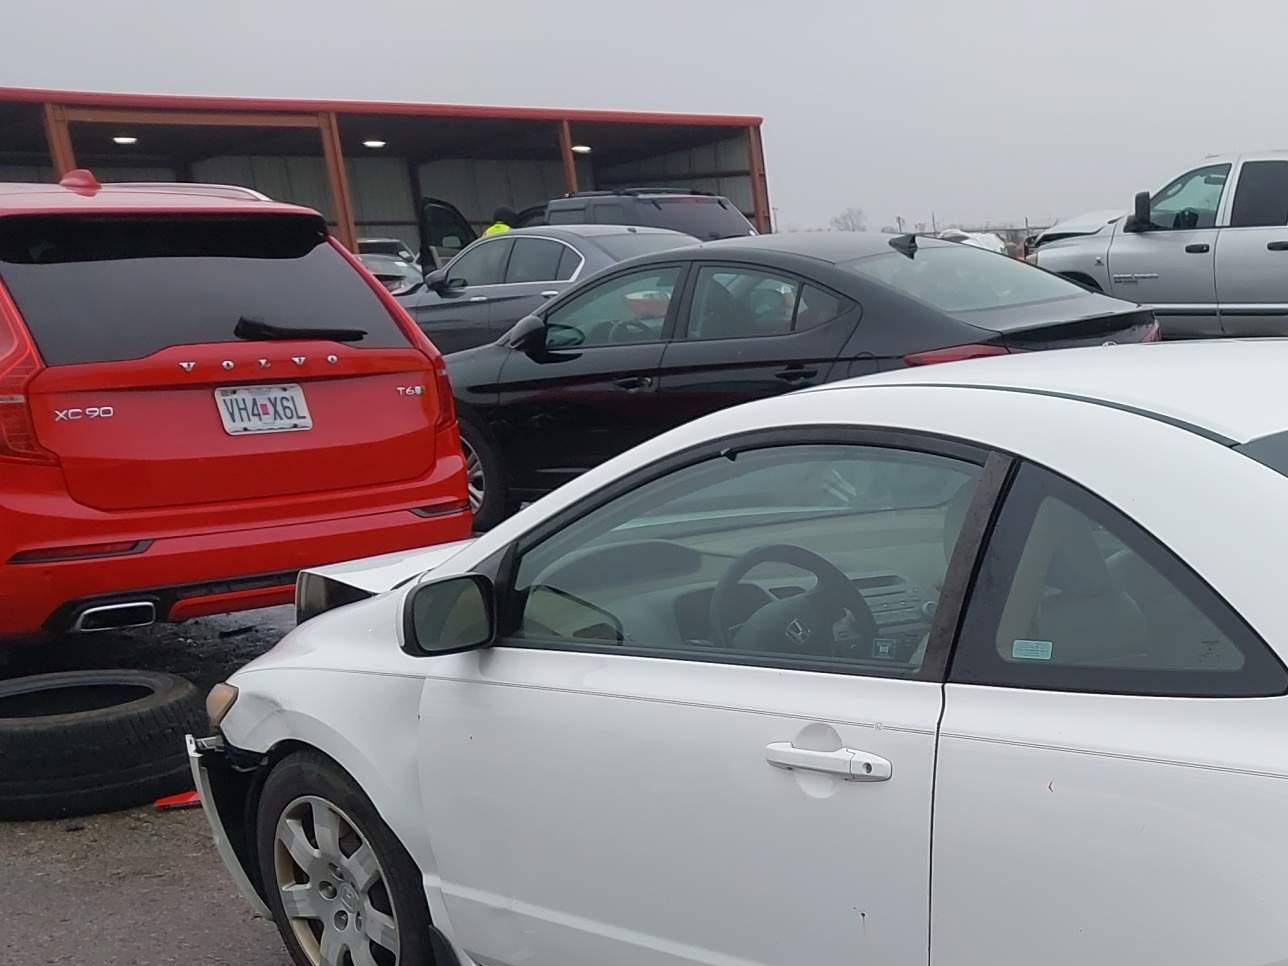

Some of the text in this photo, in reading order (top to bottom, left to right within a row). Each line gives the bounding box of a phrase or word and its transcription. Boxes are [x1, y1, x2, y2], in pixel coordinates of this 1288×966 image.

[178, 354, 338, 372] VOLVO
[222, 395, 307, 423] VH4 X6L
